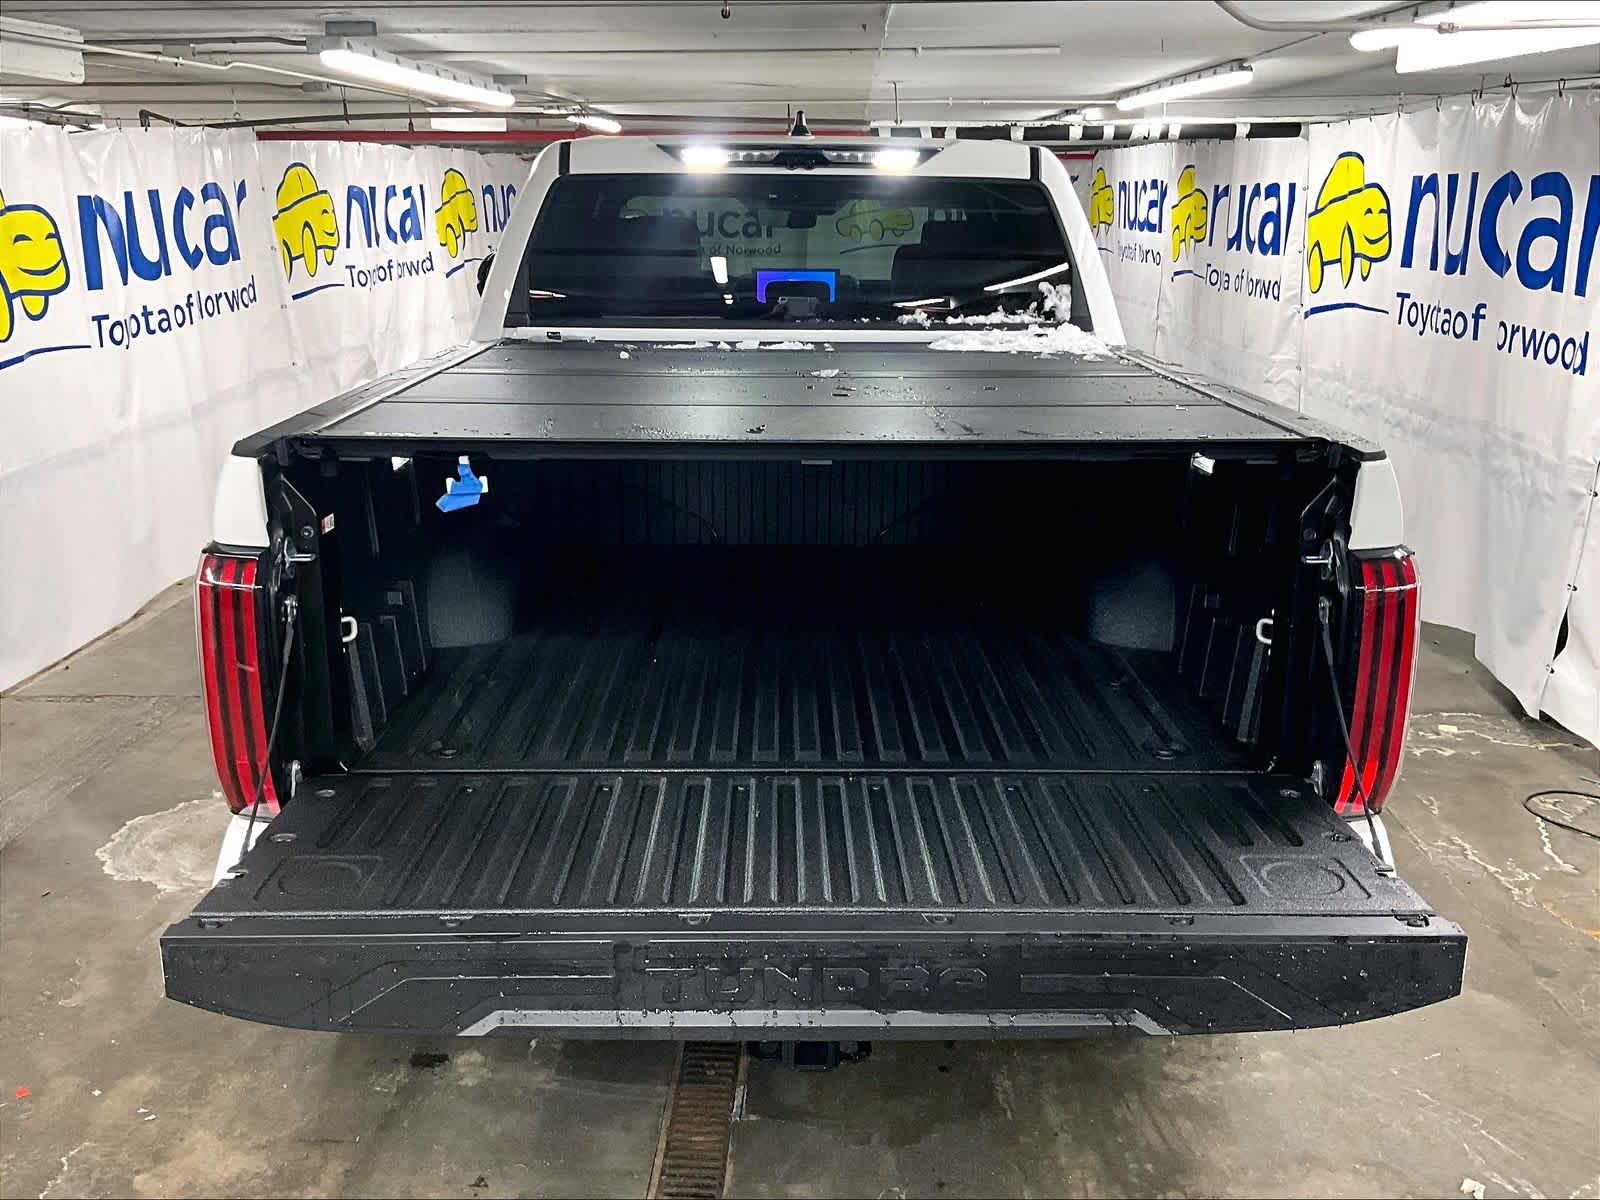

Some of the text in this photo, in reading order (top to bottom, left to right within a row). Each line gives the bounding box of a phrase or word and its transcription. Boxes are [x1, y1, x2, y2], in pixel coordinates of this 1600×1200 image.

[1117, 179, 1168, 234] nucar
[726, 243, 782, 256] Norwood
[174, 293, 194, 328] of
[1452, 303, 1488, 342] of
[1495, 320, 1590, 377] orwood
